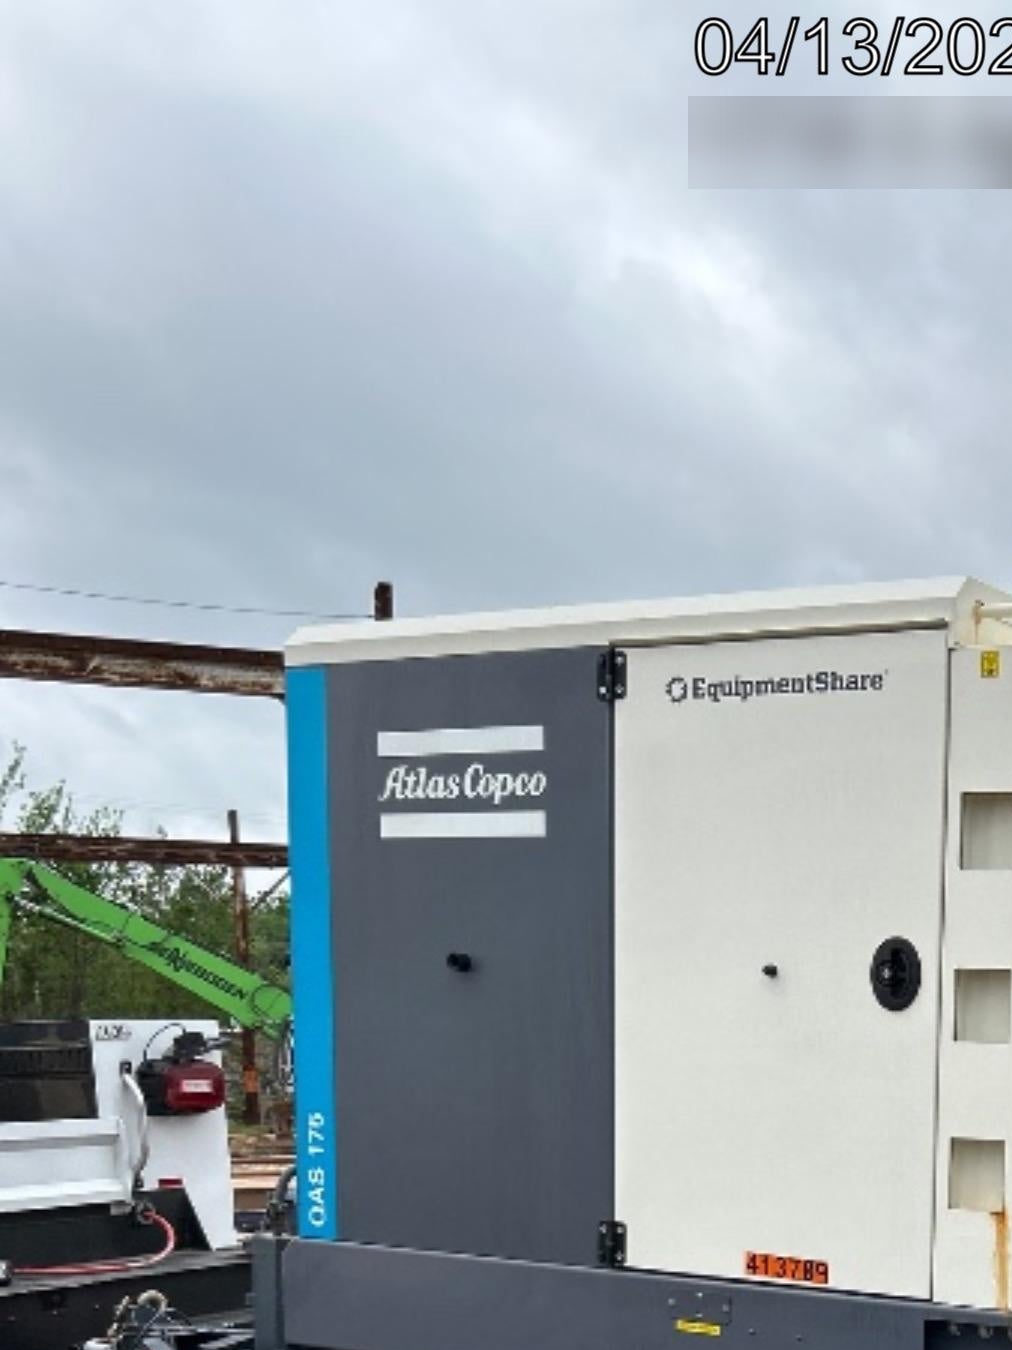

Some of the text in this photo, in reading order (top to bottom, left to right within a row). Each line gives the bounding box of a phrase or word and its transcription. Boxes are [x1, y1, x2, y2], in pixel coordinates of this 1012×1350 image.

[692, 671, 884, 702] EquipmentShare
[378, 762, 547, 805] Atlas Copco
[746, 1253, 829, 1285] 413789
